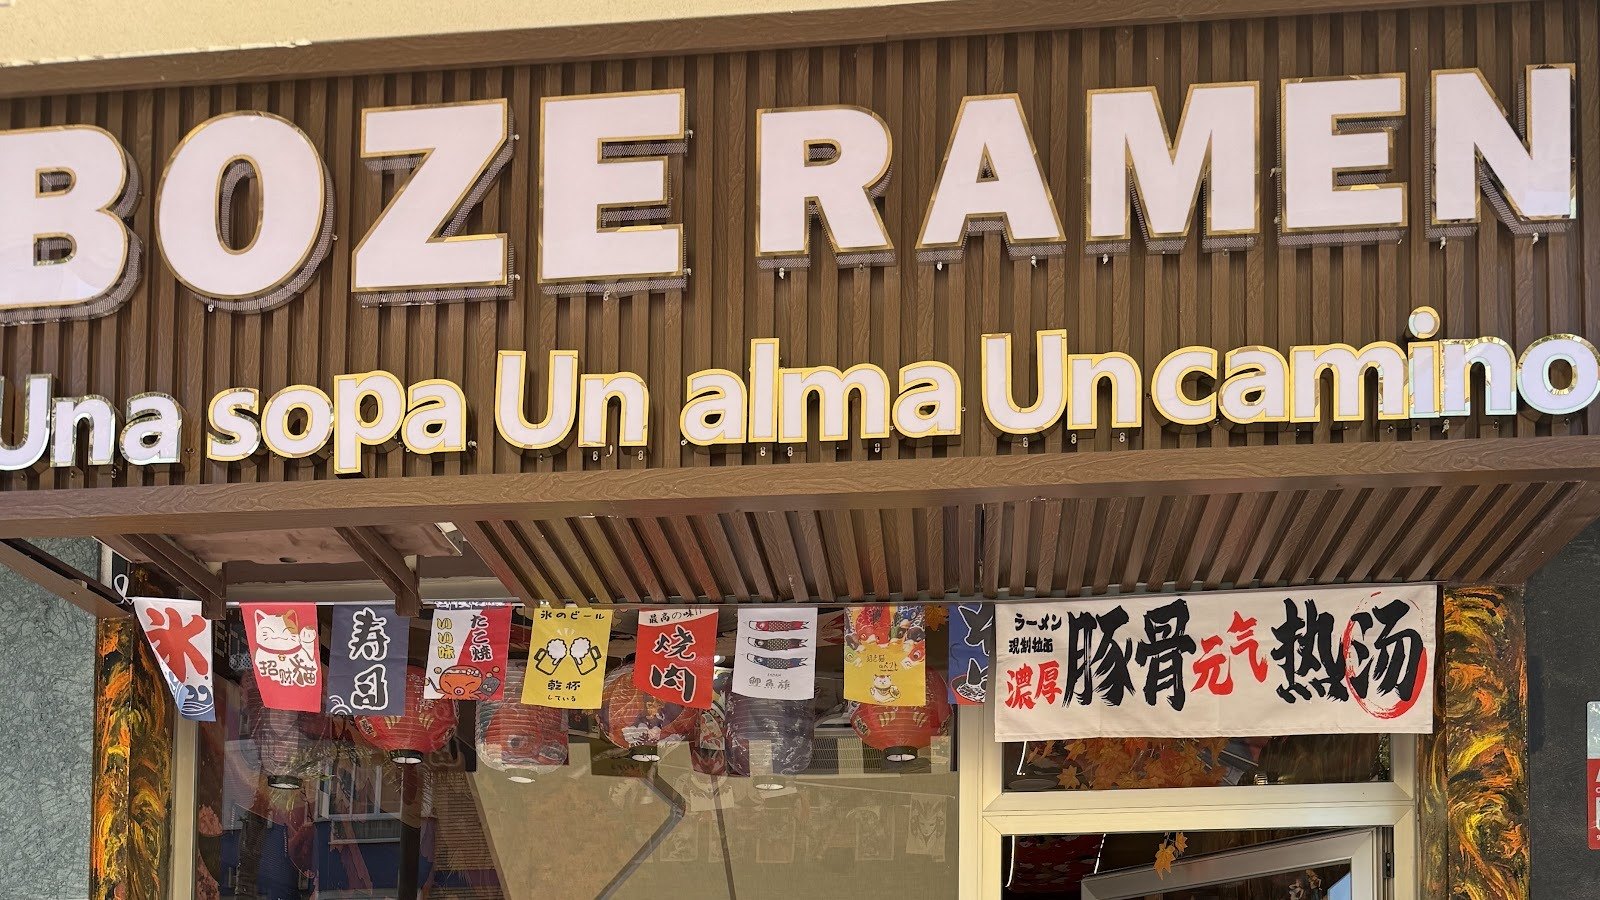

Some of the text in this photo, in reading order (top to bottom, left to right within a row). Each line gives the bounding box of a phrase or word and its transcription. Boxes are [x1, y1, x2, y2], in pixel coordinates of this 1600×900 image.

[0, 62, 1577, 309] BOZE RAMEN
[0, 305, 1600, 474] Una sopa Un alma Un camino
[1014, 612, 1062, 631] ラーメン
[548, 679, 581, 691] 乾杯
